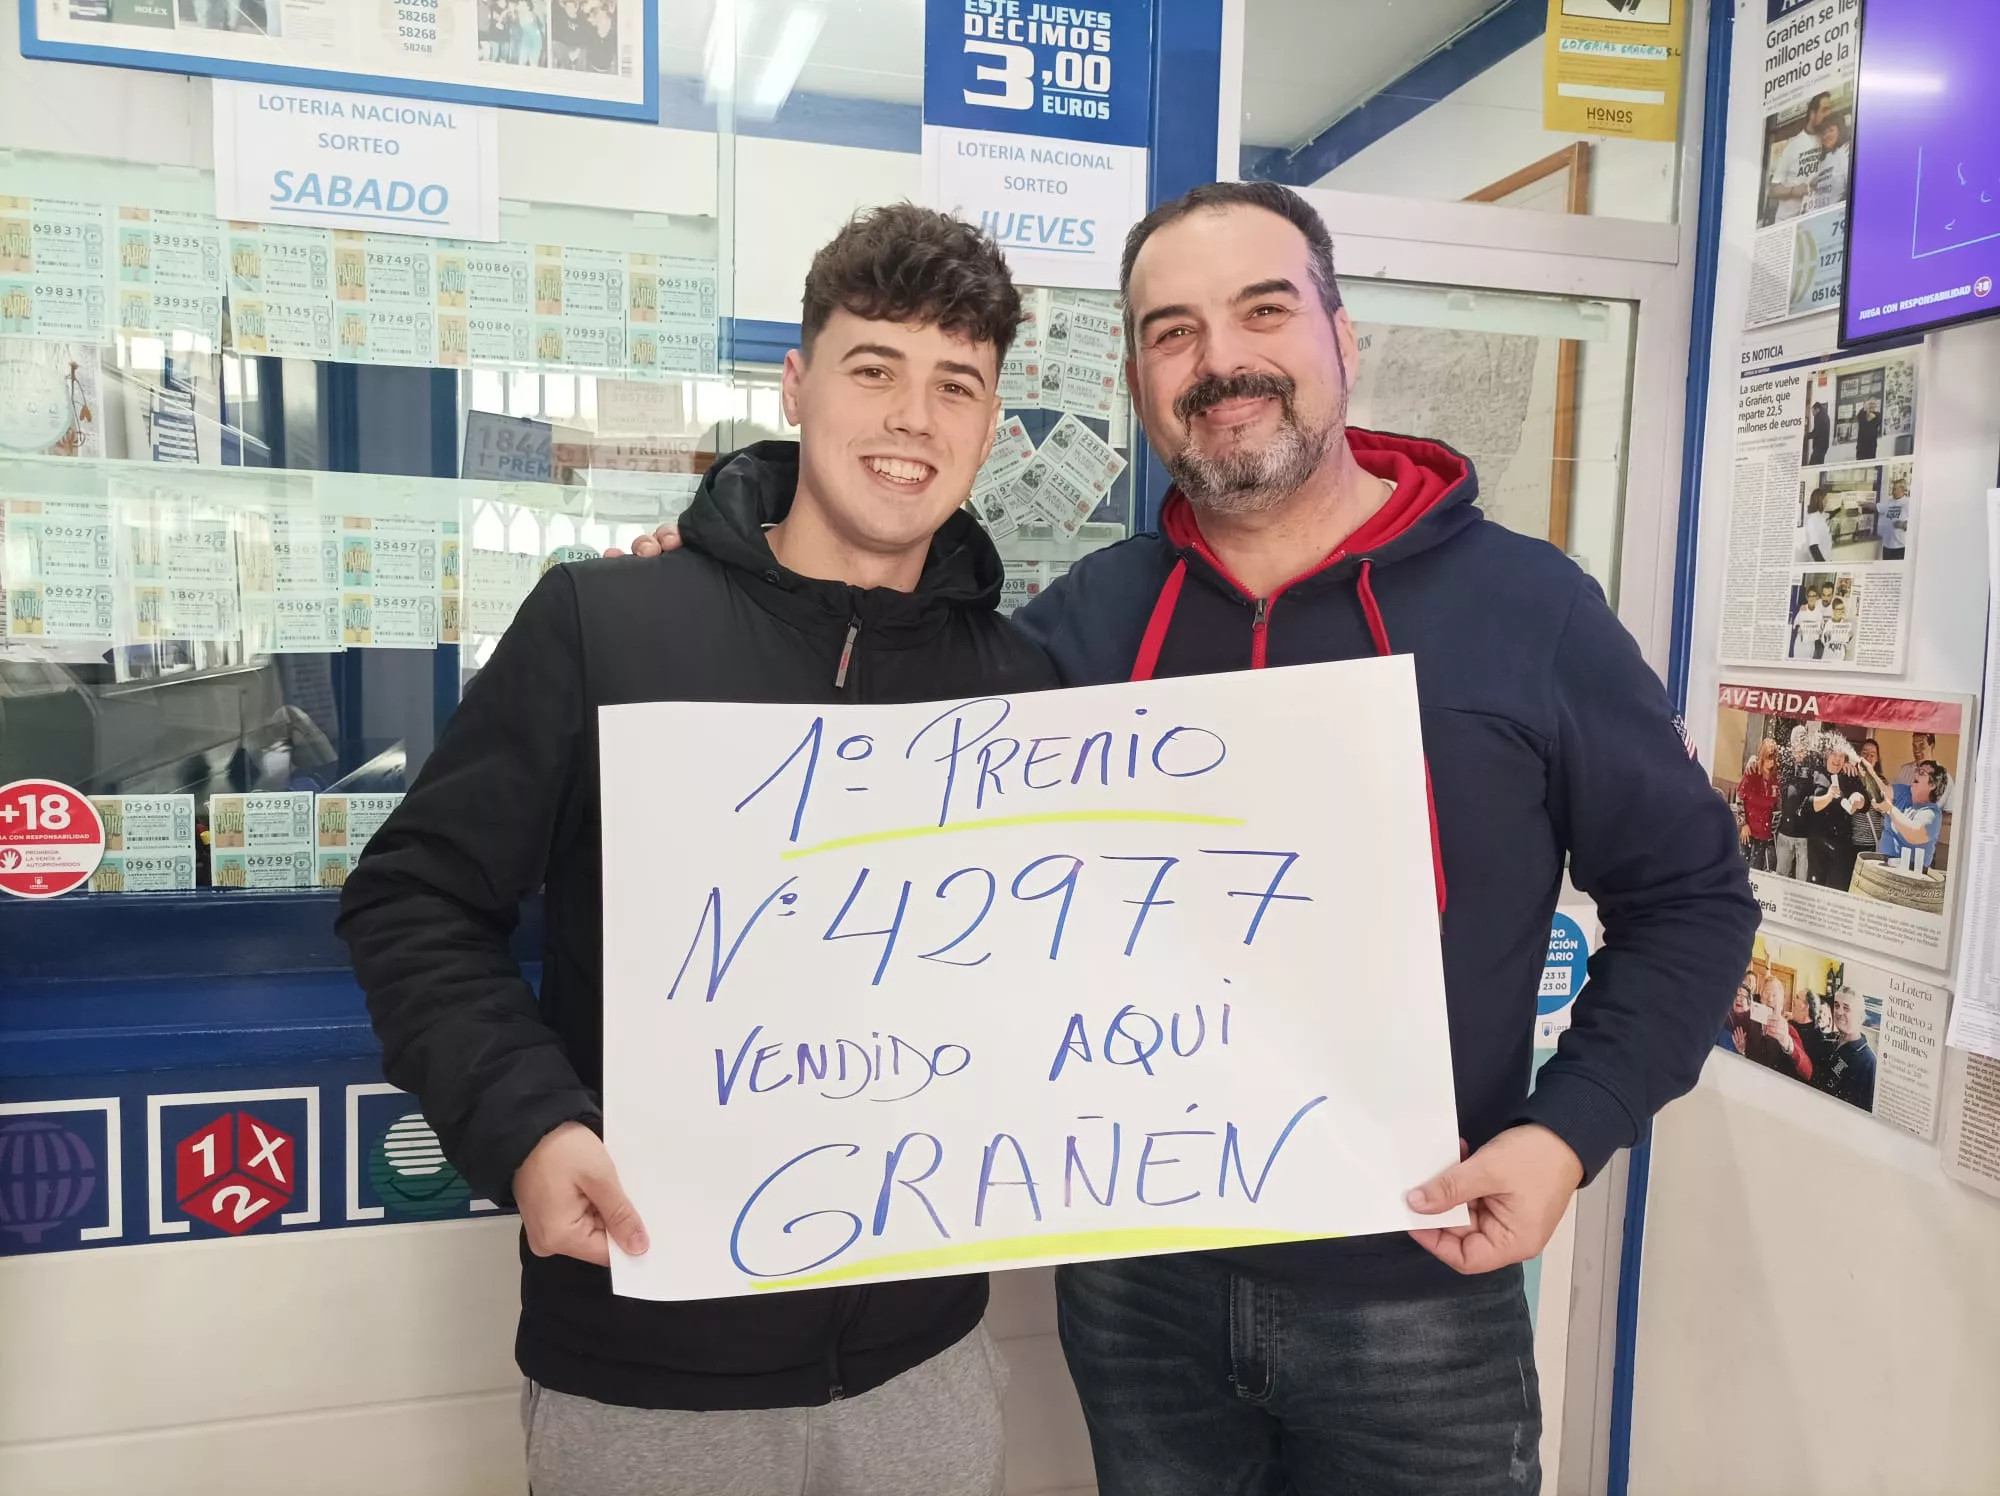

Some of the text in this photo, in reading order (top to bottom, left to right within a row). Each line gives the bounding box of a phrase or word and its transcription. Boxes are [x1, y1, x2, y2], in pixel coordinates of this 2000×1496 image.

[398, 9, 436, 23] 58268
[965, 0, 1112, 30] ESTE JUEVES
[398, 26, 436, 40] 58268
[1766, 14, 1815, 49] Grañén
[1818, 5, 1834, 25] se
[1765, 34, 1821, 73] millones
[1824, 21, 1849, 44] con
[963, 39, 1112, 110] 3,00
[1764, 60, 1811, 100] premio
[1815, 49, 1833, 72] de
[1836, 42, 1849, 62] la
[258, 94, 457, 129] LOTERIA NACIONAL
[1042, 95, 1111, 120] EUROS
[1586, 106, 1634, 124] HONOS
[317, 132, 401, 156] SORTEO
[957, 141, 1114, 171] LOTERIA NACIONAL
[270, 169, 450, 216] SABADO
[1003, 175, 1069, 195] SORTEO
[981, 210, 1096, 248] JUEVES
[1882, 303, 1898, 315] CON
[1741, 345, 1784, 364] ES NOTICIA
[1740, 375, 1800, 395] La suerte vuelve
[1775, 391, 1791, 404] que
[1738, 405, 1783, 422] reparte 22,5
[1737, 416, 1802, 435] millones de euros
[1719, 687, 1820, 717] AVENIDA
[0, 793, 71, 831] +18
[125, 802, 171, 812] 09610
[246, 799, 291, 809] 66799
[350, 800, 393, 810] 51983
[26, 833, 90, 841] RESPONSABILIDAD
[126, 860, 172, 870] 09610
[247, 856, 293, 866] 66799
[821, 848, 1316, 987] 42977
[1545, 972, 1567, 980] 23 13
[1889, 977, 1900, 991] La
[1543, 983, 1568, 991] 23 00
[1887, 1005, 1898, 1019] de
[1899, 1012, 1926, 1029] nuevo
[1891, 1038, 1928, 1060] millones
[1918, 1034, 1936, 1048] con
[192, 1134, 215, 1178] 1
[247, 1123, 286, 1184] X
[729, 1095, 1328, 1279] GRAÑÉN
[211, 1184, 271, 1224] 2
